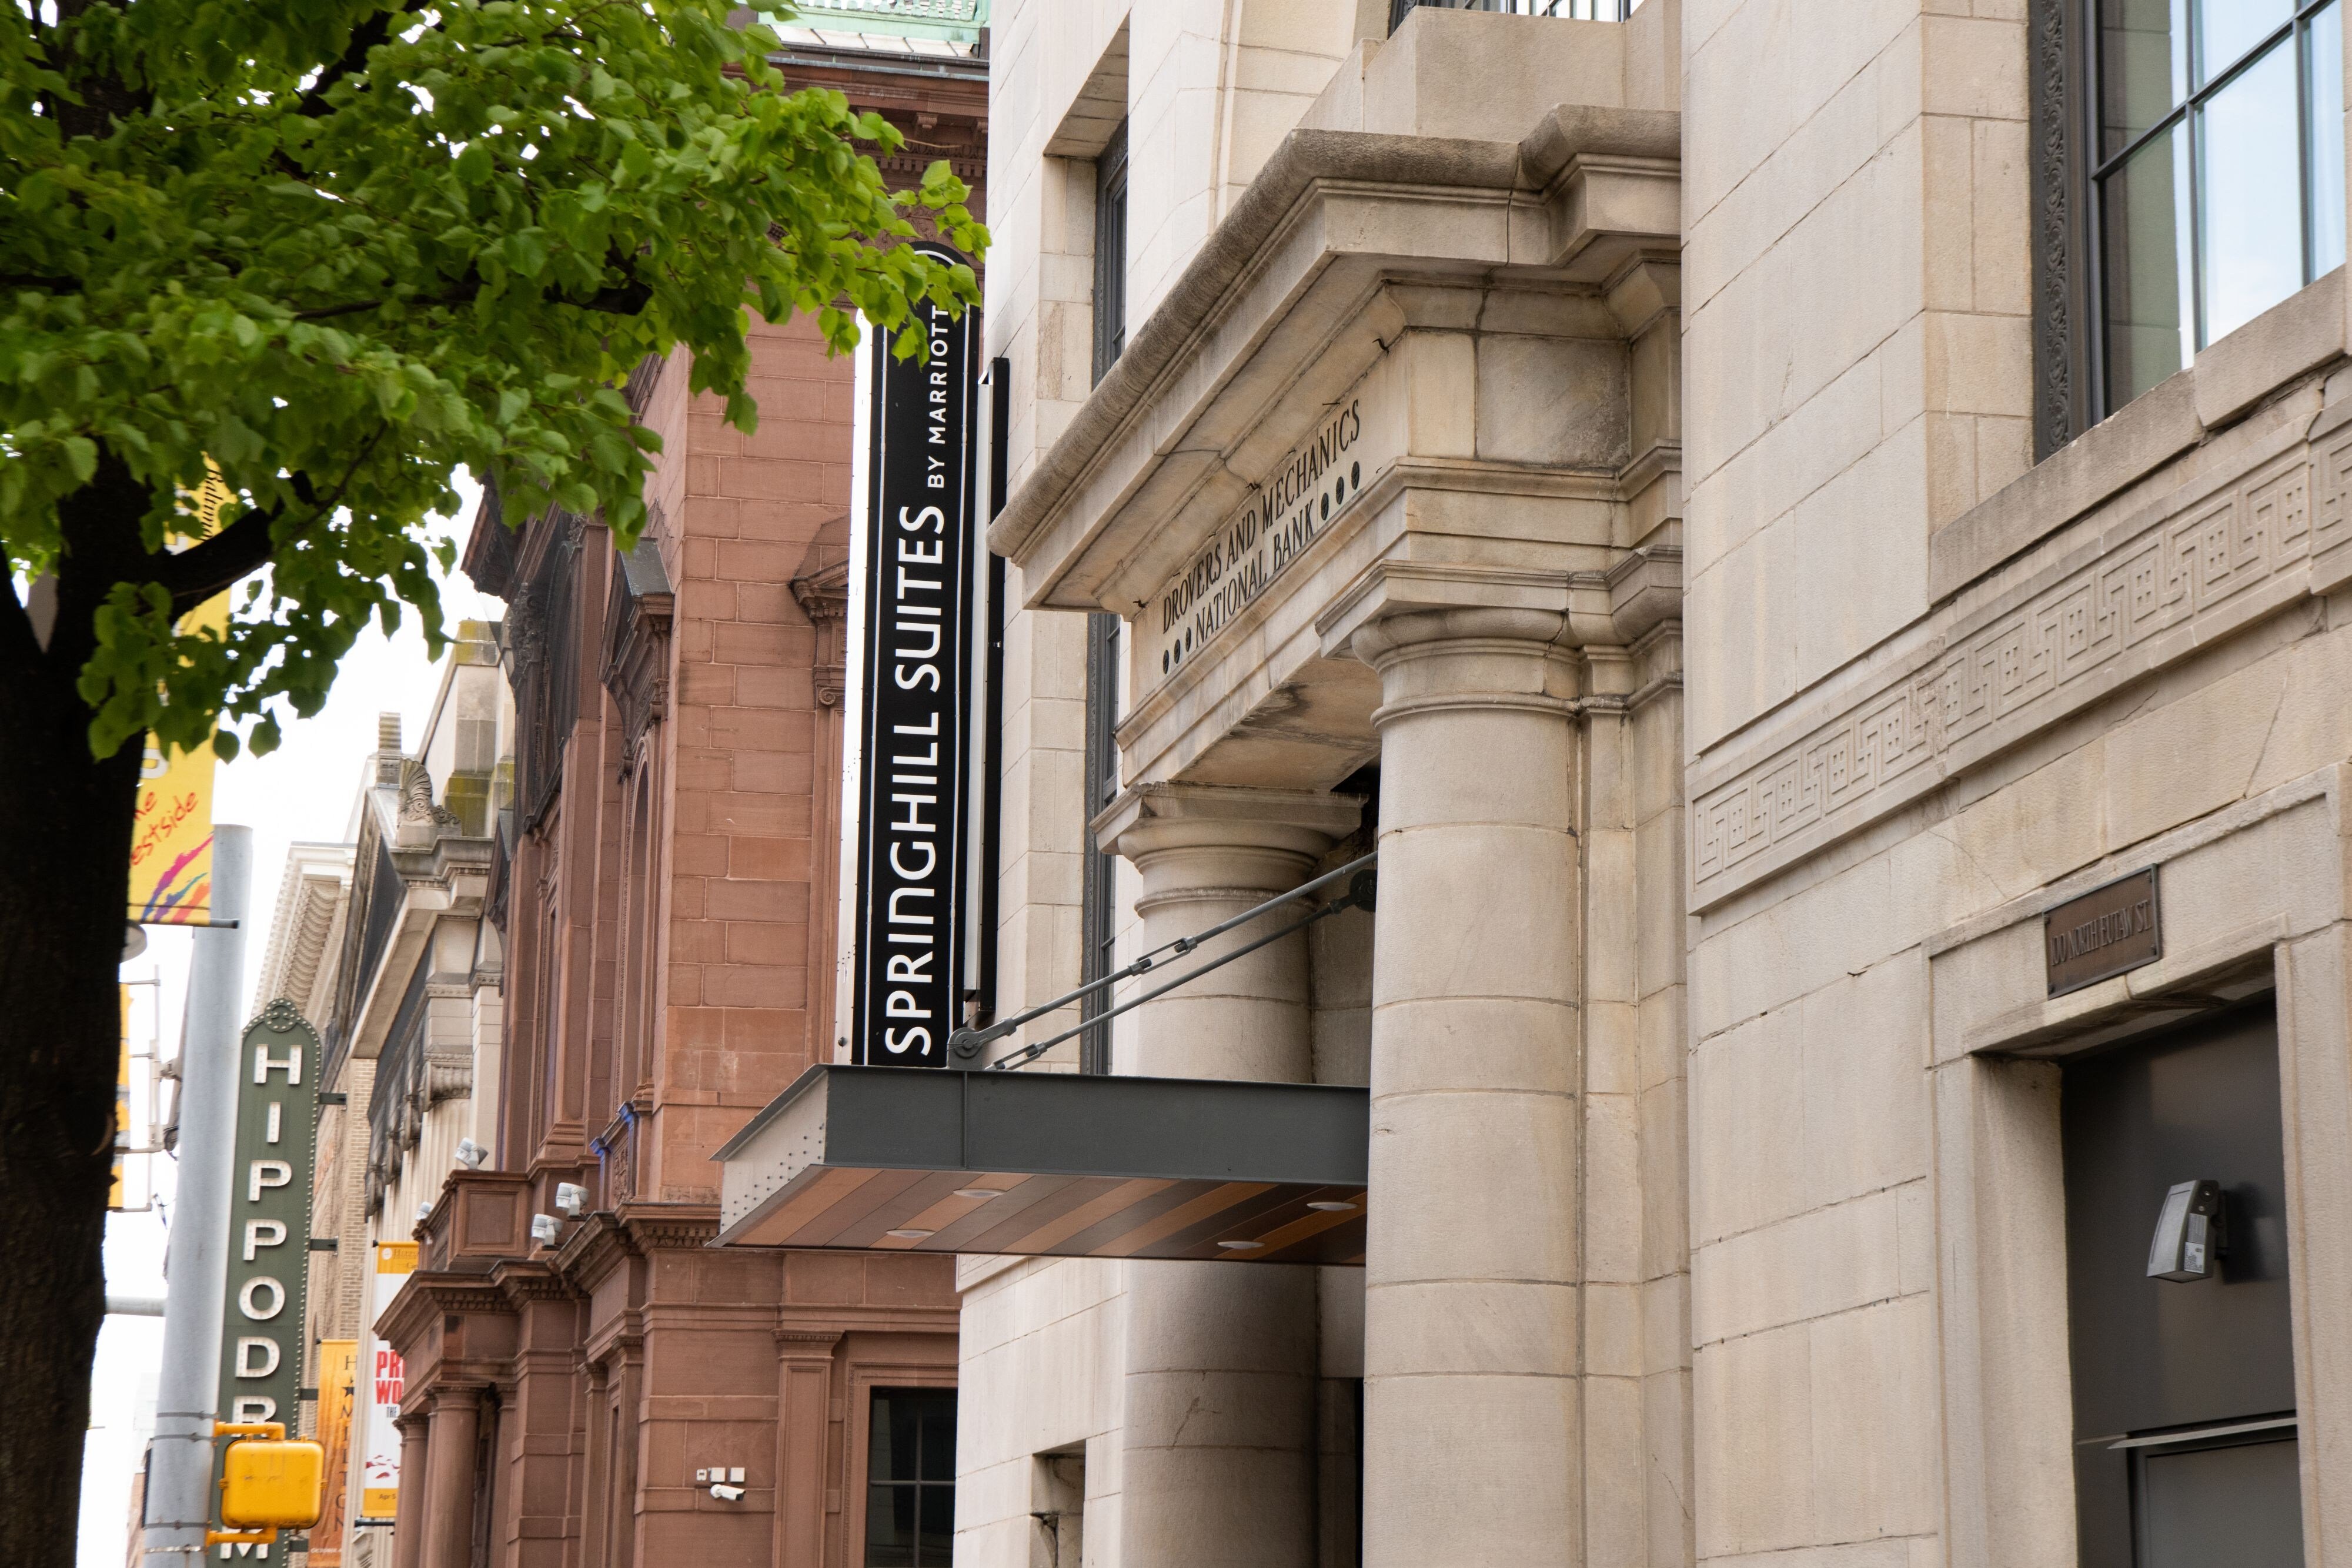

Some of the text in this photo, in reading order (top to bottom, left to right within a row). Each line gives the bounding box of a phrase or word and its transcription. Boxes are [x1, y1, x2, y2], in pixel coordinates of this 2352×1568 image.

[927, 305, 948, 488] BY MARRIOTT
[1162, 399, 1361, 634] DROVERS AND MECHANICS
[1195, 499, 1315, 648] NATIONAL BANK
[131, 792, 199, 865] estside
[885, 506, 944, 1056] SPRINGHILL SUITES
[220, 1043, 302, 1559] HIPPODRM
[387, 1406, 397, 1418] THE
